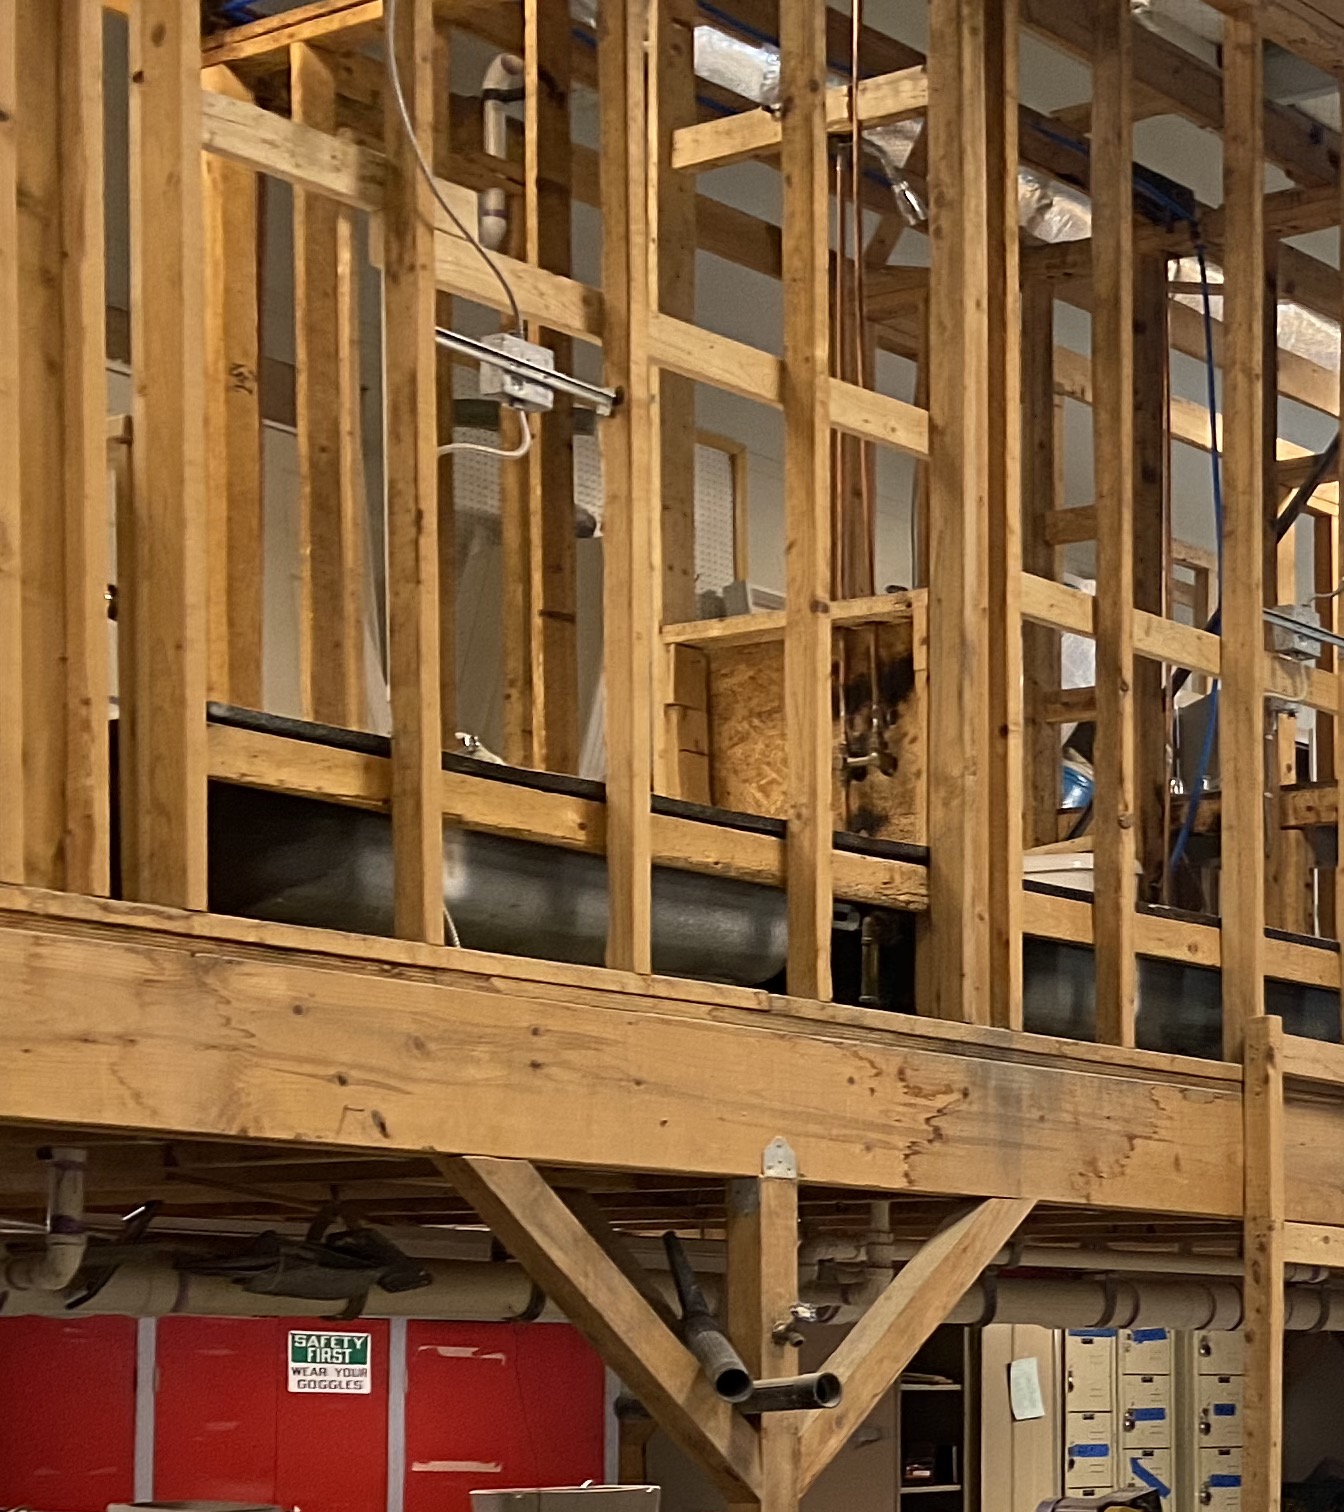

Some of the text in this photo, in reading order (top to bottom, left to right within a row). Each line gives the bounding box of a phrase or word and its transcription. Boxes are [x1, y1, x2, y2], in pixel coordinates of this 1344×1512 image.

[293, 1334, 366, 1350] SAFETY
[307, 1348, 353, 1363] FIRST
[291, 1367, 368, 1378] WEAR YOUR
[297, 1379, 363, 1390] GOGGLES
